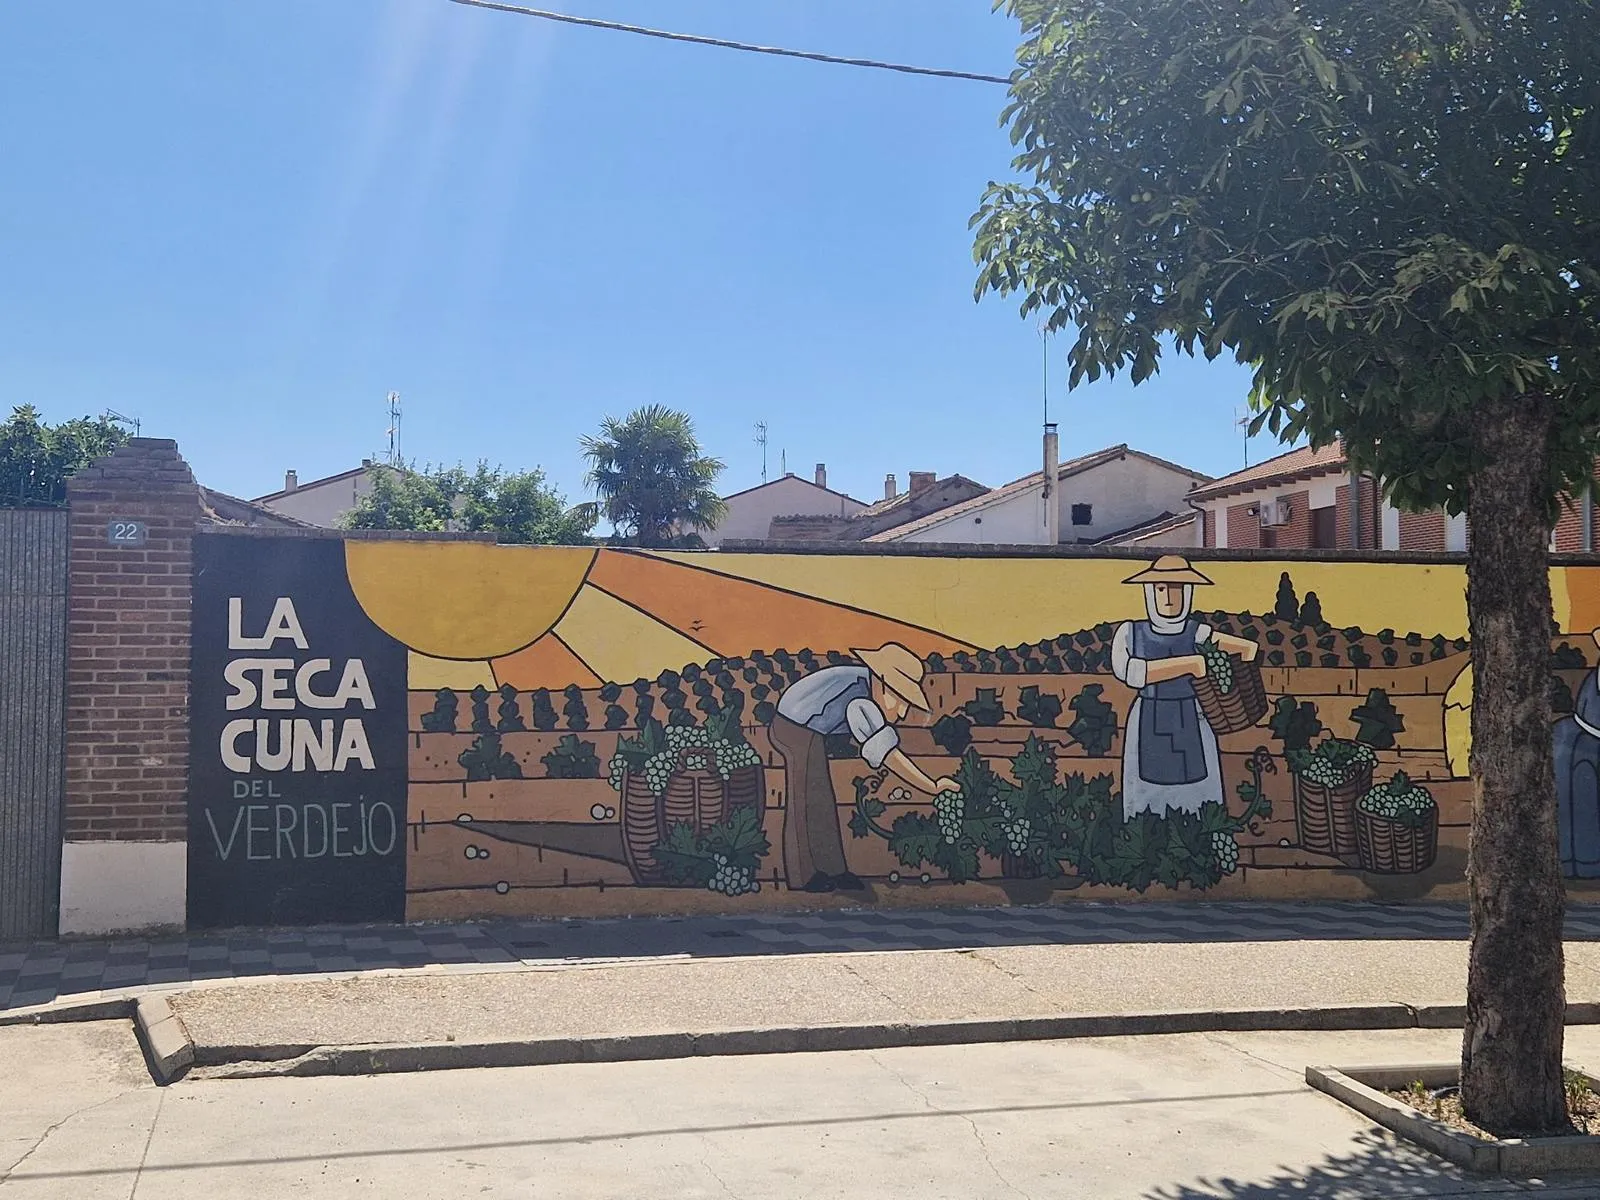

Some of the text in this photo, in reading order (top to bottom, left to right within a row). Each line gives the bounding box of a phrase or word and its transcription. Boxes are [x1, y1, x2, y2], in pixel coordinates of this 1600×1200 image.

[115, 523, 137, 540] 22
[228, 597, 310, 650] LA
[223, 658, 377, 711] SECA
[220, 718, 376, 773] CUNA
[233, 780, 281, 798] DEL
